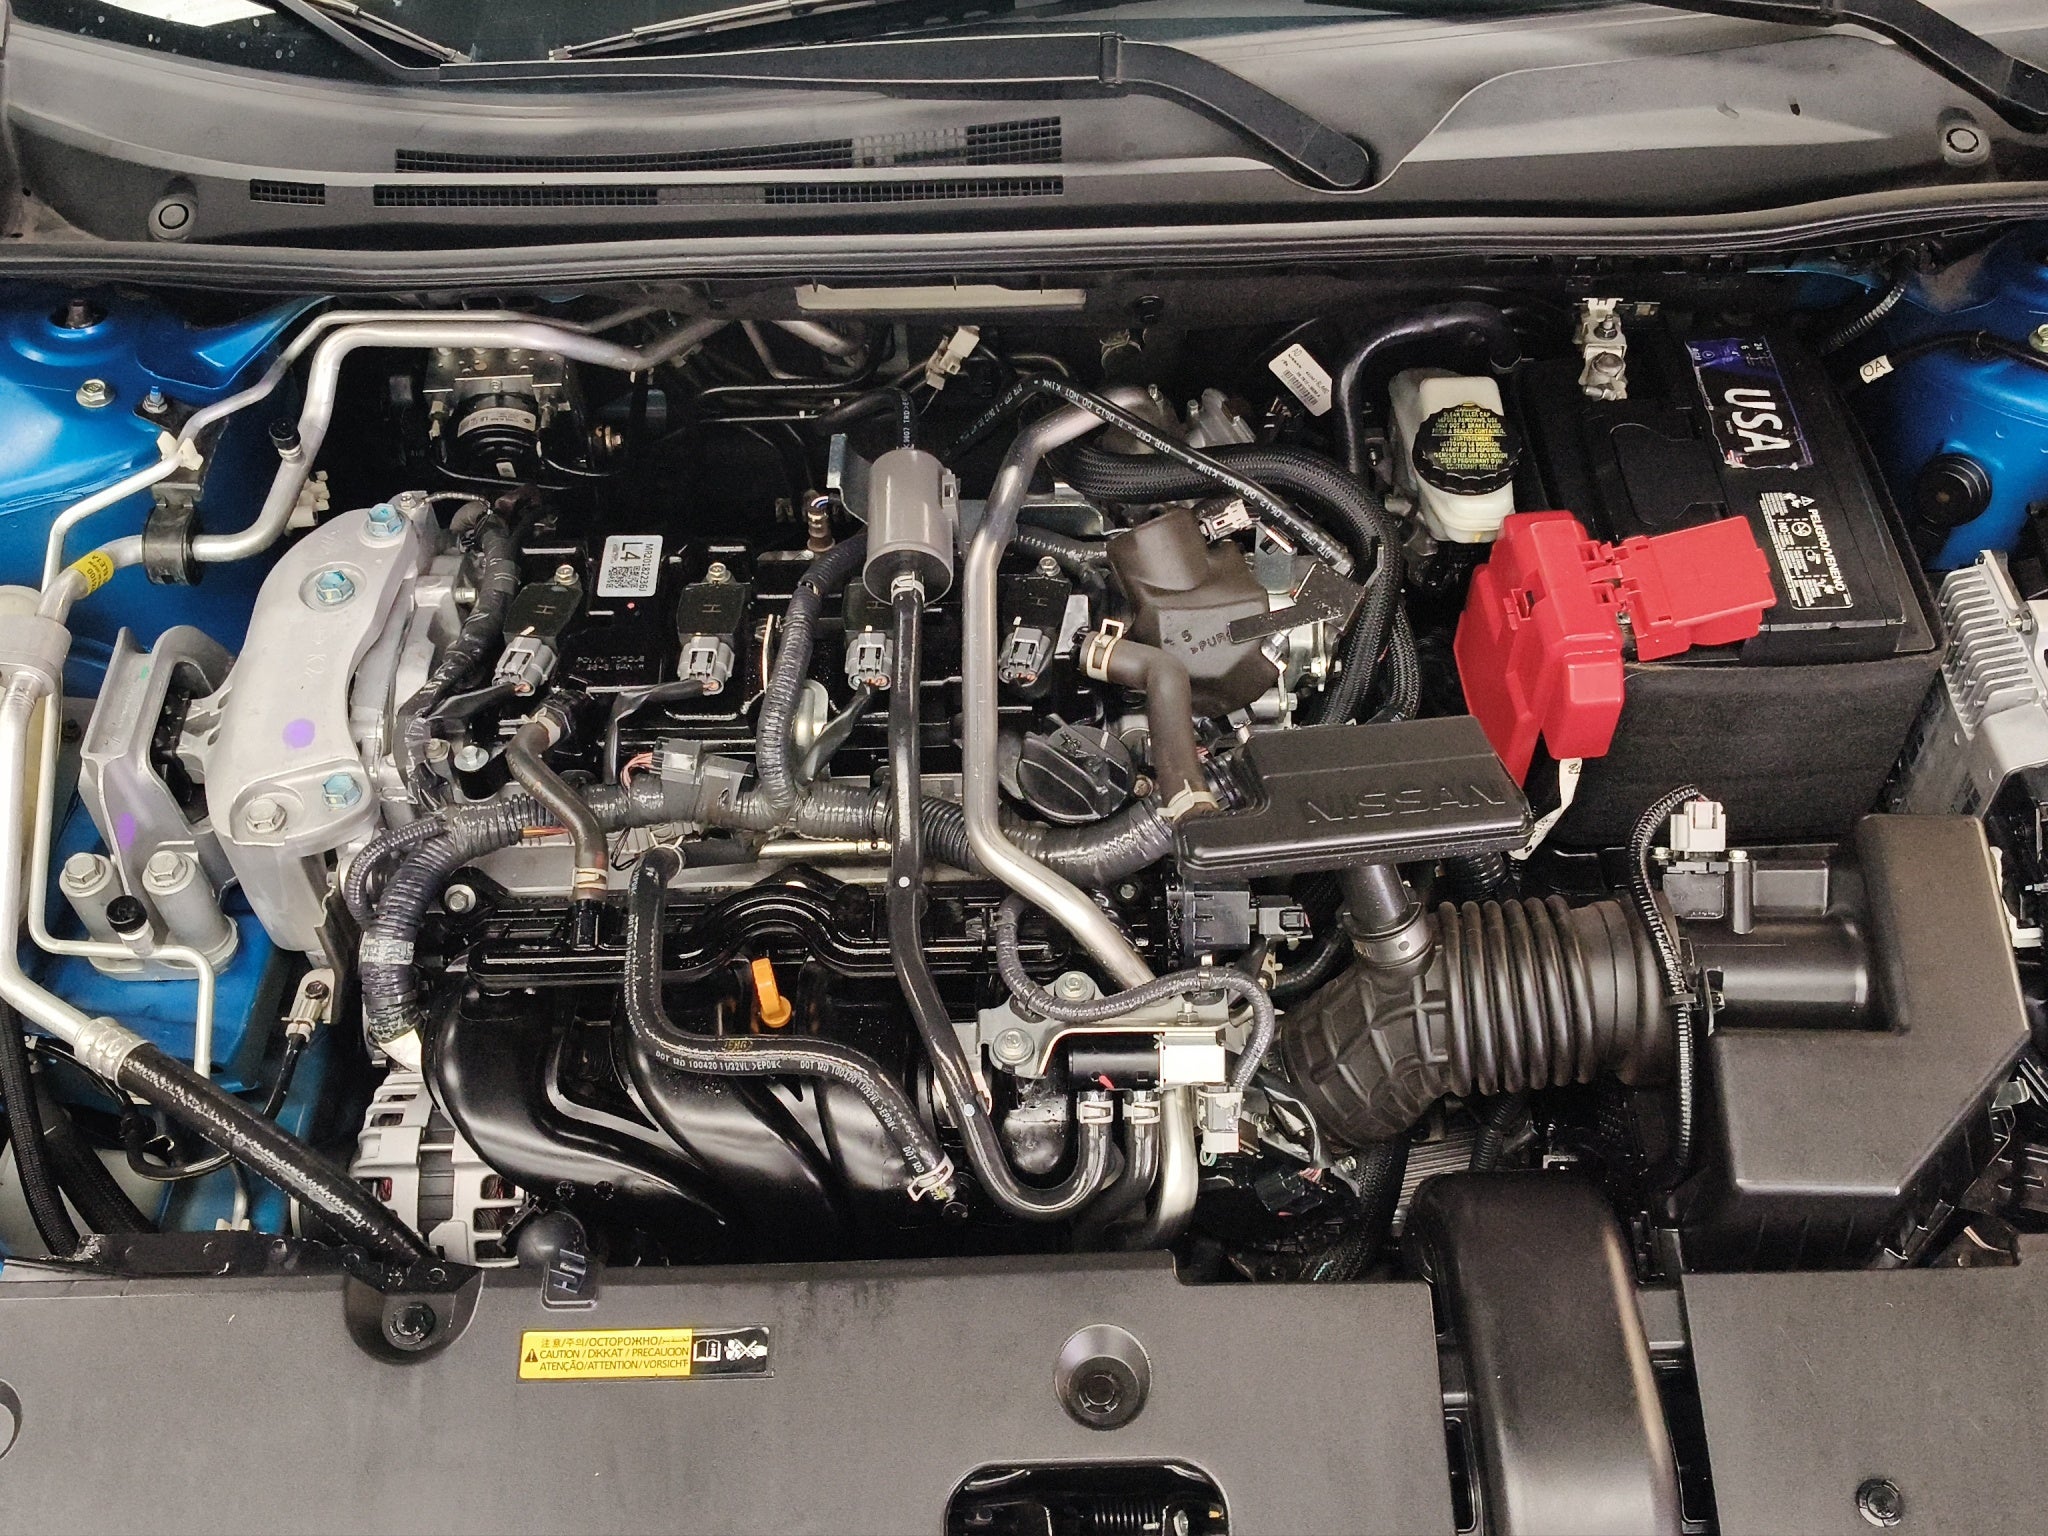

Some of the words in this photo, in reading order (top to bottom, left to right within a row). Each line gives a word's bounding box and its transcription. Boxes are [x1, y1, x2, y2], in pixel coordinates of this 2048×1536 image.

[1724, 388, 1790, 452] USA
[620, 542, 644, 562] L4
[1308, 786, 1506, 824] NISSAN
[540, 1350, 580, 1358] CAUTION
